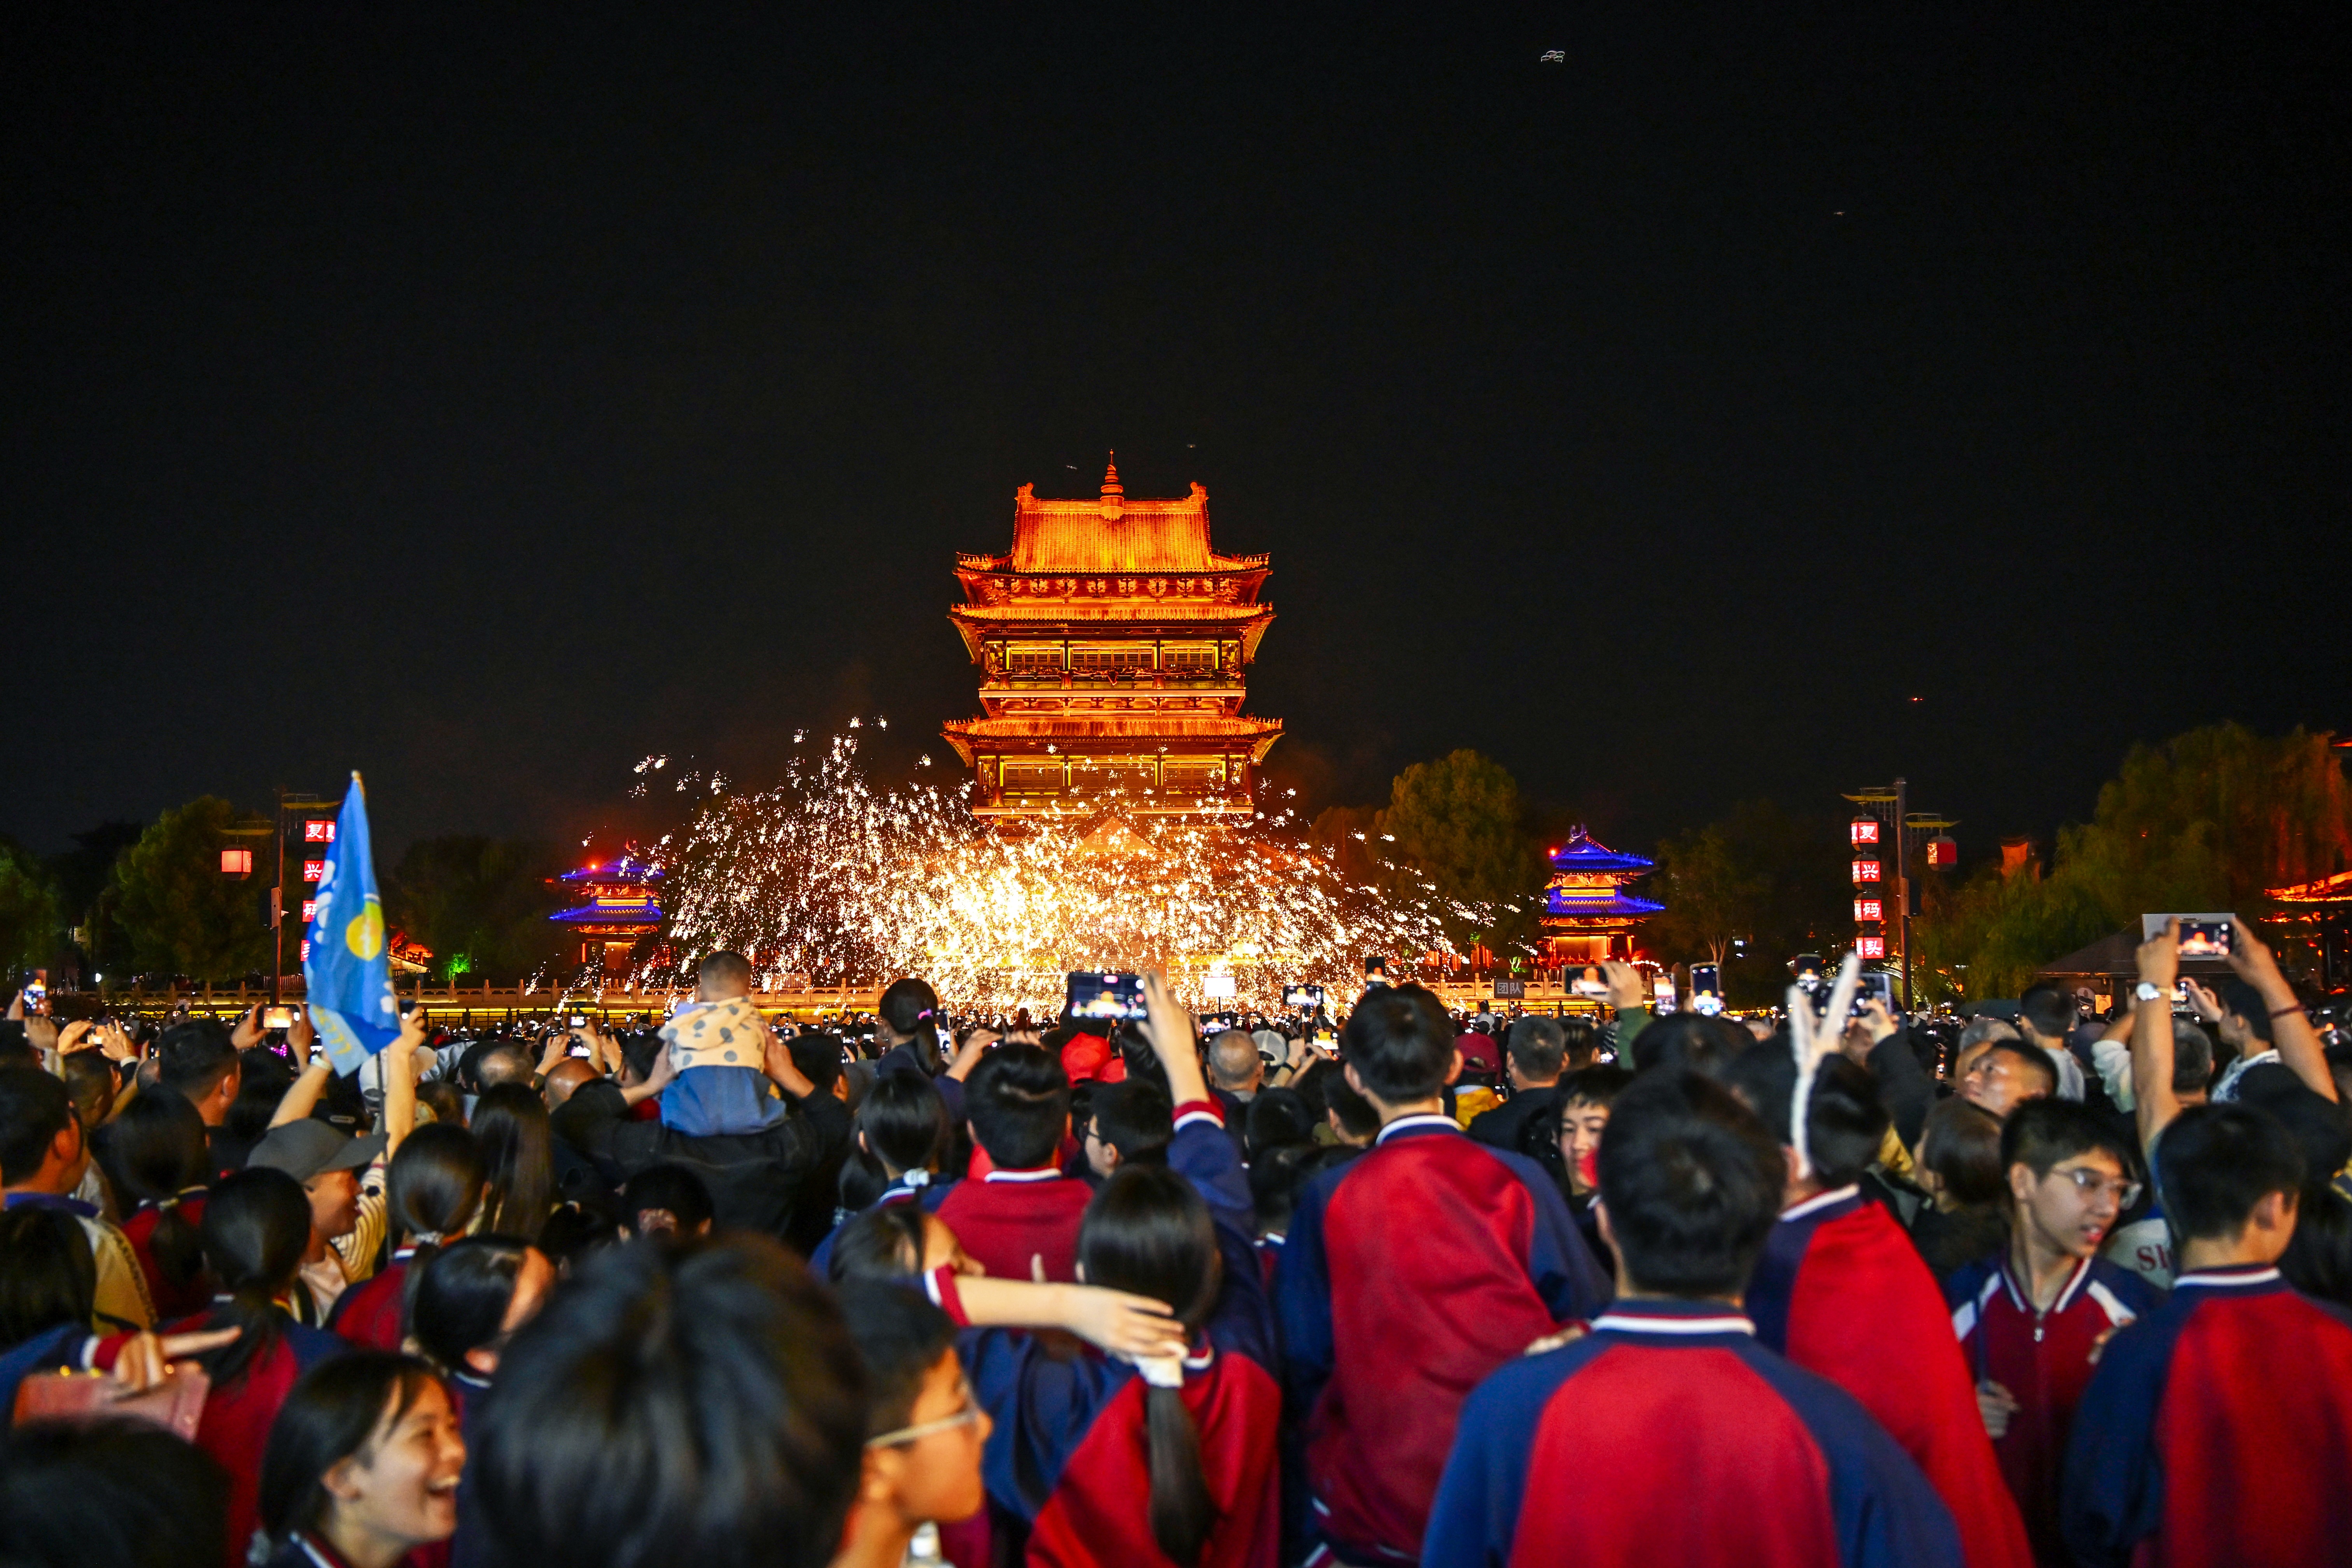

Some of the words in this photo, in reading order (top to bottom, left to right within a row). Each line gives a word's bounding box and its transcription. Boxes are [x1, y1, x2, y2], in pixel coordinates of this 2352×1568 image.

[1860, 825, 1882, 956] 复兴码头
[1497, 982, 1522, 994] 团队
